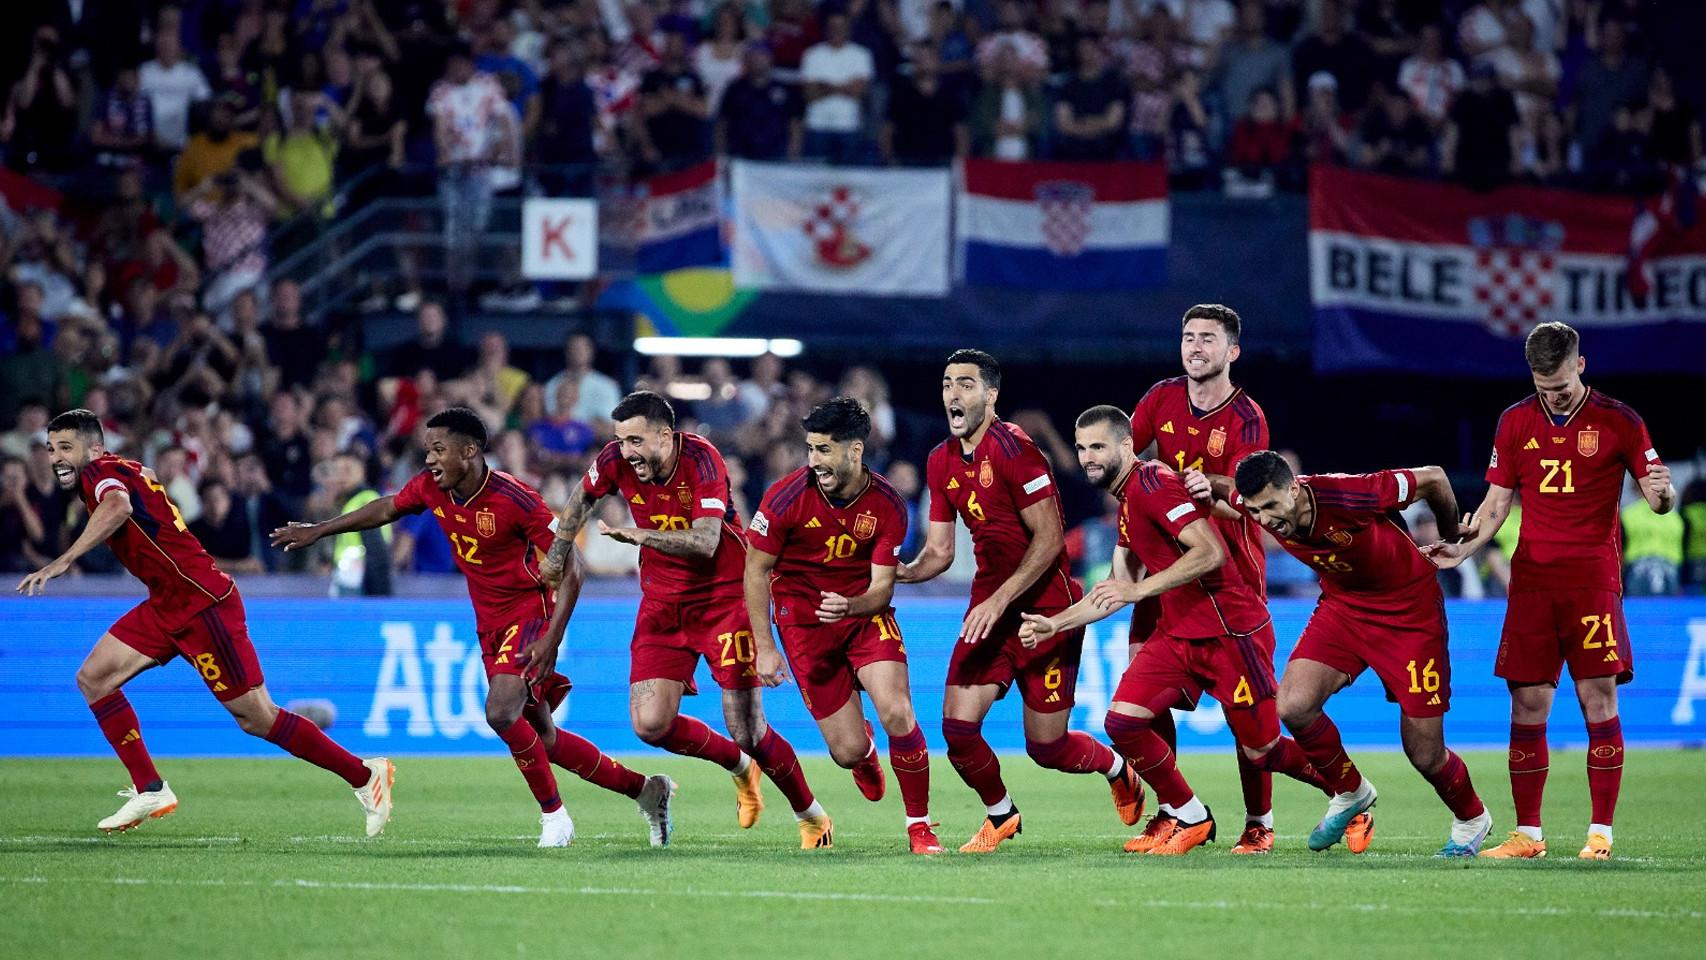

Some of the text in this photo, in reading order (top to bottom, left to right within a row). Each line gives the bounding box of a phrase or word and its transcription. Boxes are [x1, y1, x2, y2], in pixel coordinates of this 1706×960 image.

[541, 214, 576, 262] K
[1329, 244, 1462, 306] BELE
[1540, 459, 1575, 493] 21
[967, 490, 986, 521] 6
[450, 532, 483, 565] 12
[823, 533, 858, 563] 10
[1581, 613, 1617, 649] 21
[717, 630, 755, 667] 20
[1044, 657, 1061, 689] 6
[1406, 658, 1440, 693] 16
[1233, 675, 1254, 706] 4
